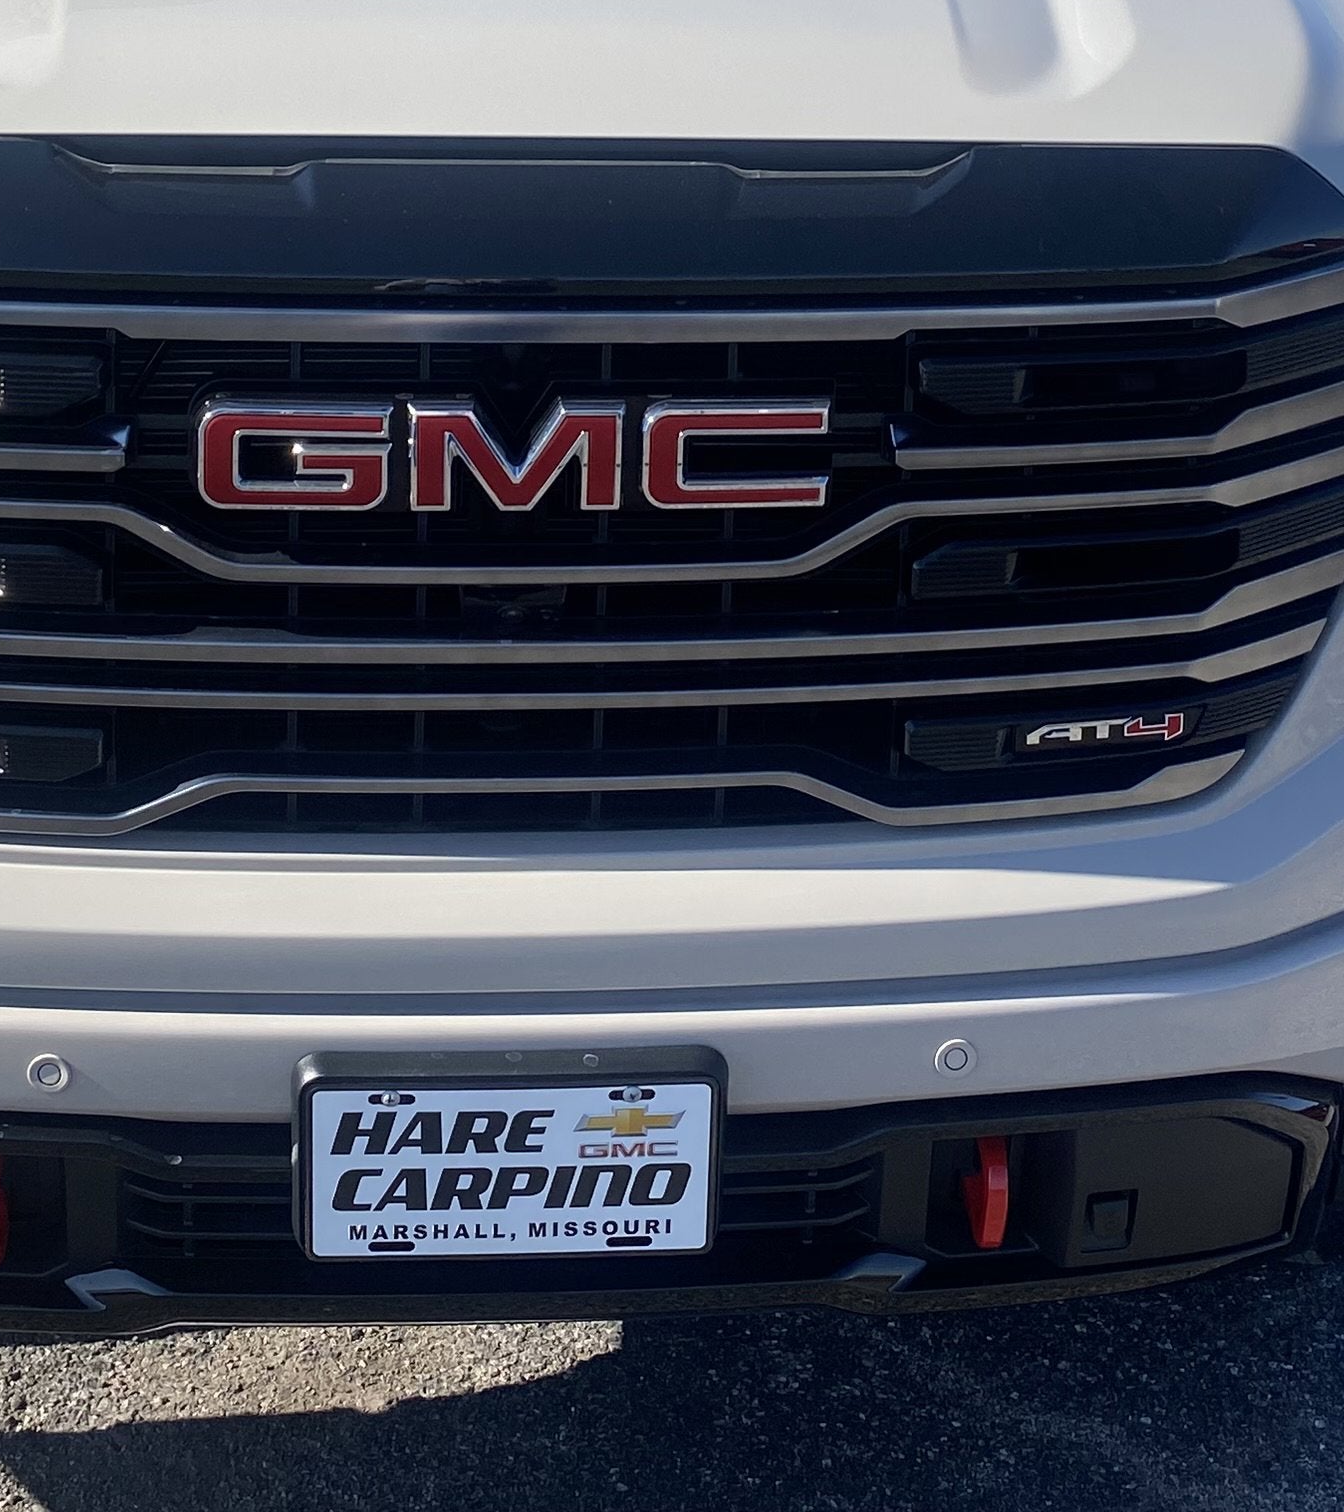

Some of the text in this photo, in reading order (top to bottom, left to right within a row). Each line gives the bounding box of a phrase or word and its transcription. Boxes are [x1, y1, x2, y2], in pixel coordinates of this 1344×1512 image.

[198, 394, 832, 512] GMC
[1026, 712, 1184, 746] AT4
[329, 1109, 555, 1156] HARE
[577, 1140, 679, 1159] GMC
[330, 1162, 692, 1212] CARPINO
[348, 1219, 672, 1242] MARSHALL, MISSOURI
